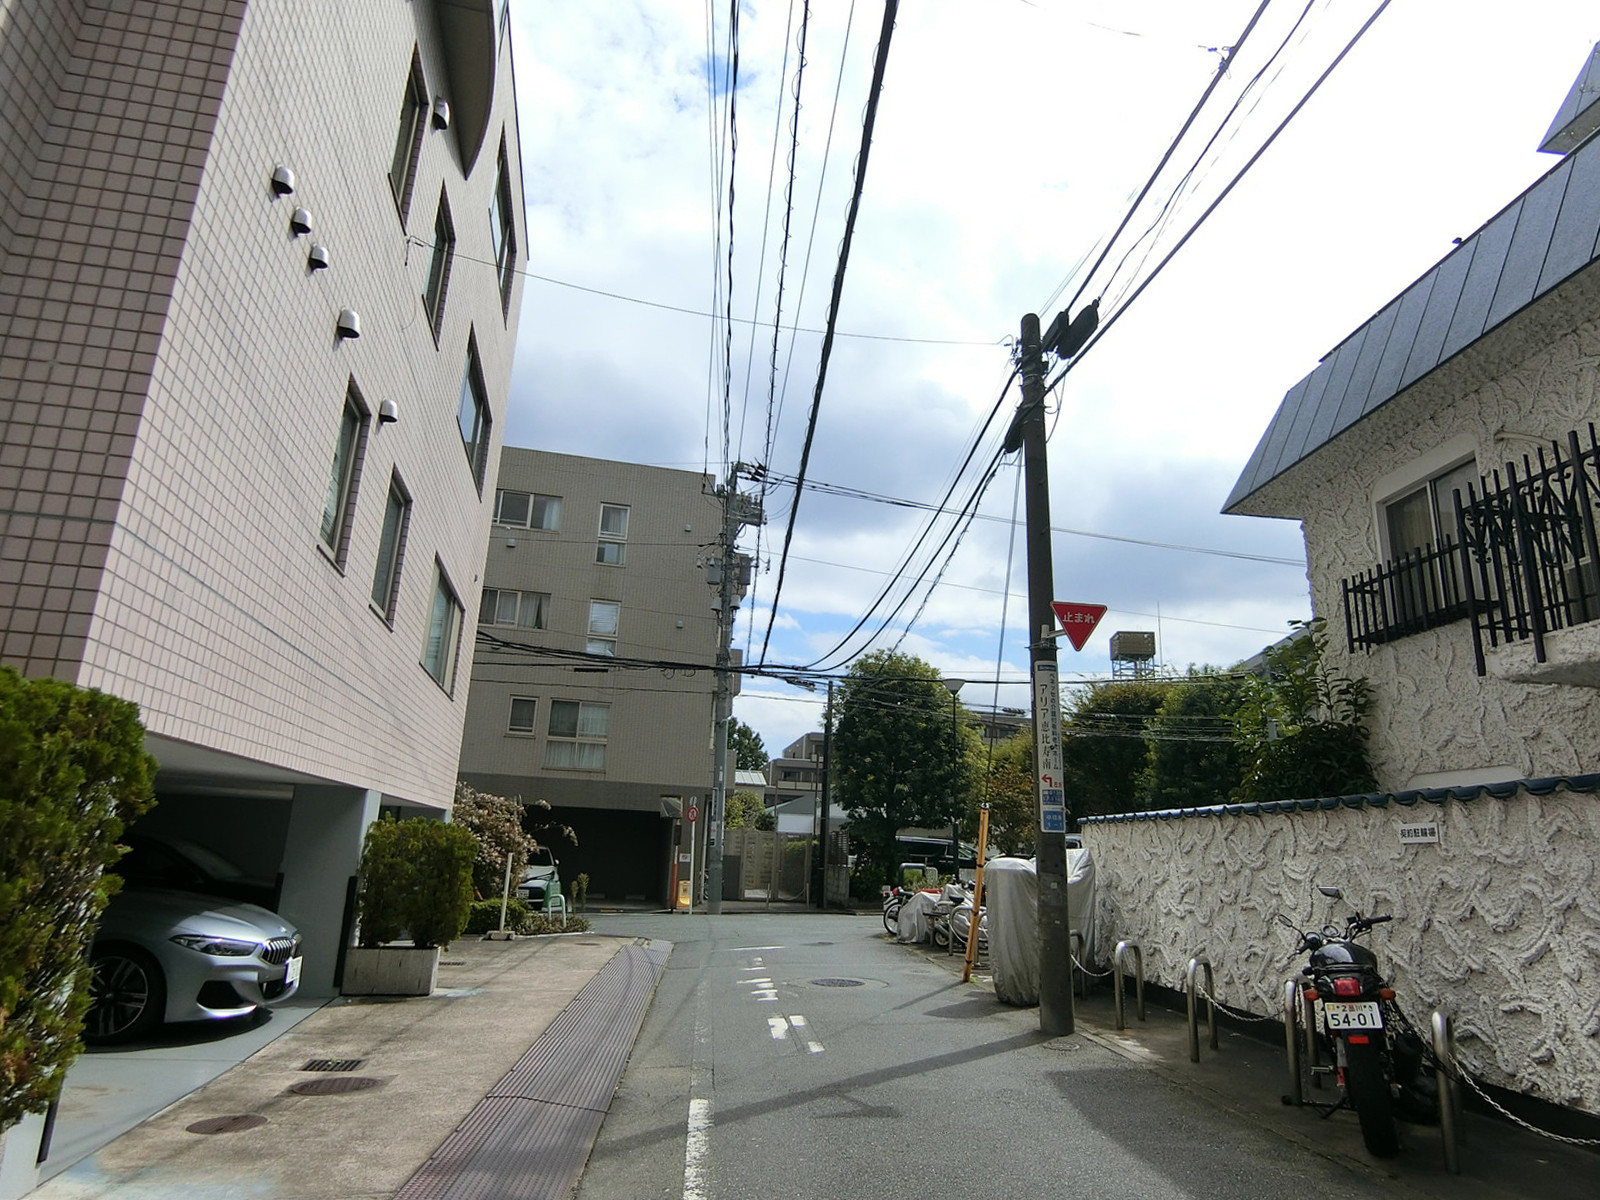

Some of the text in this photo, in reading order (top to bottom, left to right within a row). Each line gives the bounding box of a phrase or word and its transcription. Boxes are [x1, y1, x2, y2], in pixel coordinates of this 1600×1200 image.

[1062, 611, 1095, 624] 止まれ
[1040, 684, 1051, 770] アリア恵比寿南
[1331, 1013, 1375, 1027] 54-01
